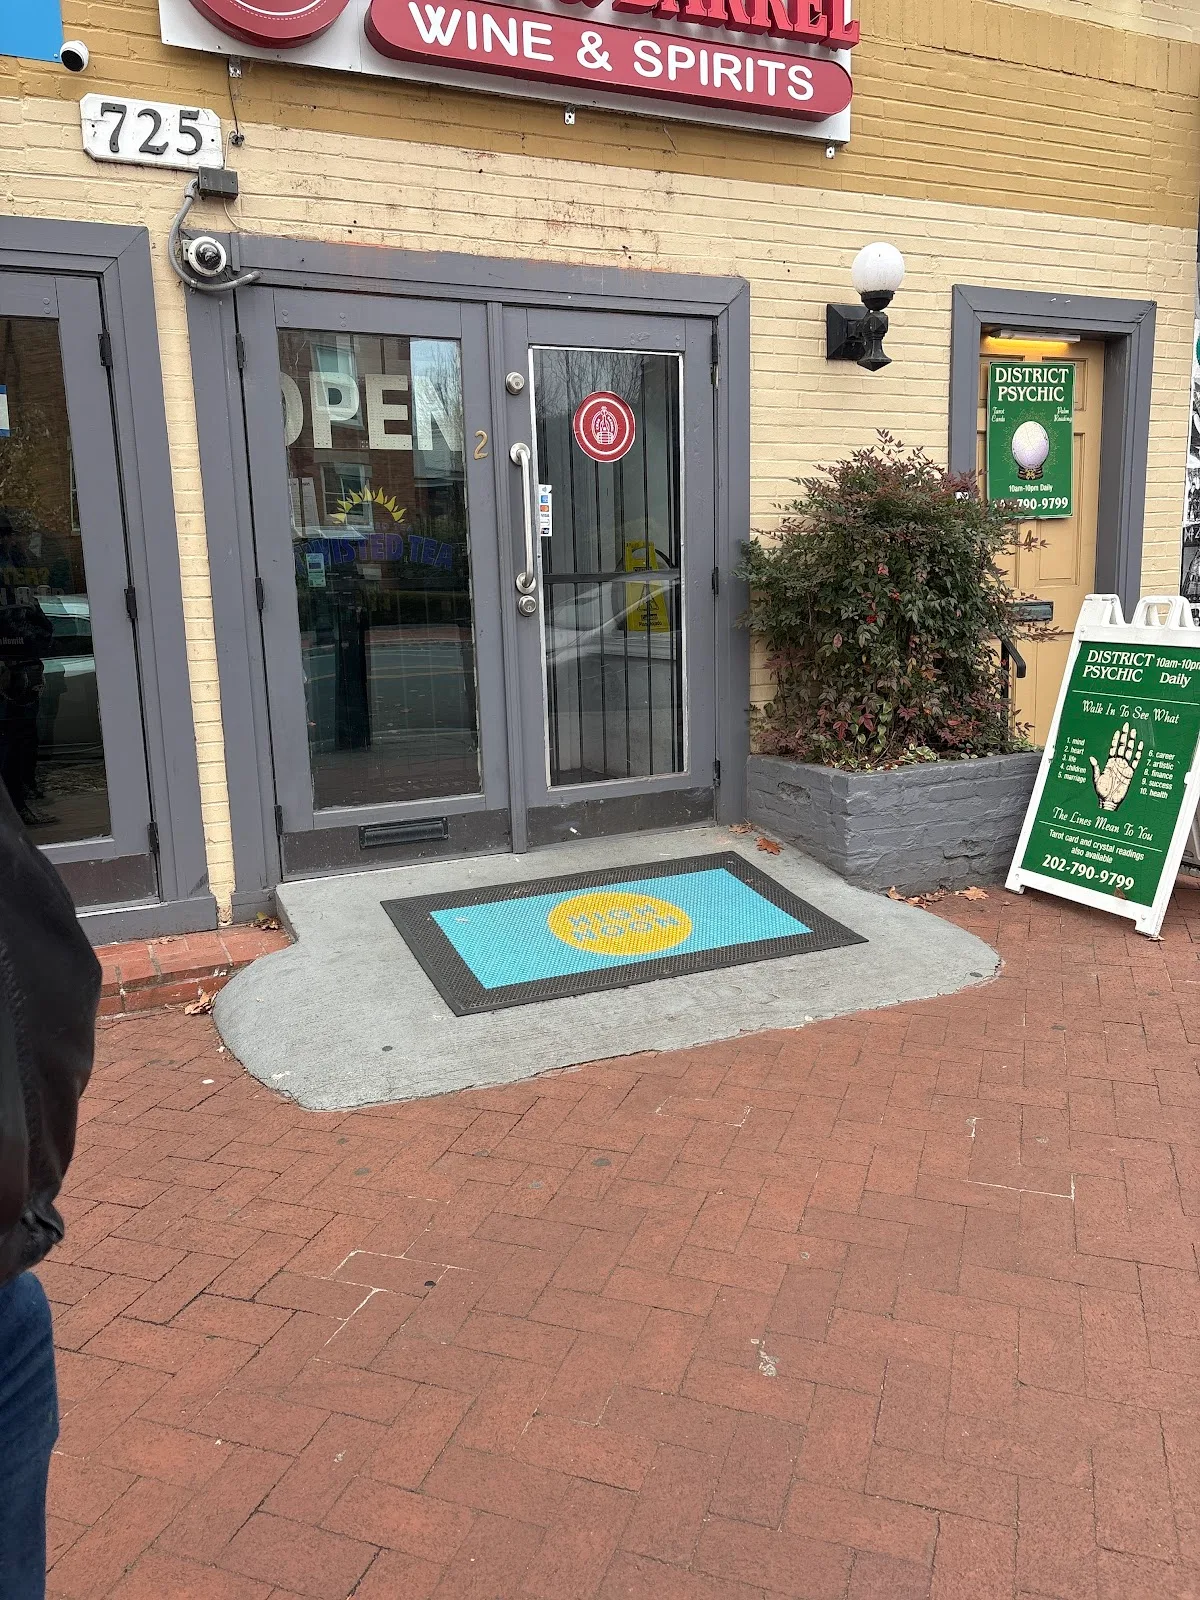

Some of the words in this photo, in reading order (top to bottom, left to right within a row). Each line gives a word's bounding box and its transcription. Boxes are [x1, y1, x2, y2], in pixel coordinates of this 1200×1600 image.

[612, 0, 860, 50] REL
[408, 1, 555, 62] WINE
[576, 30, 613, 72] &
[633, 39, 814, 101] SPIRITS
[101, 102, 203, 155] 725
[995, 367, 1069, 383] DISTRICT
[997, 386, 1065, 402] PSYCHIC
[473, 430, 488, 460] 2
[1008, 485, 1039, 493] 10am-10pm
[1040, 484, 1053, 492] Daily
[993, 497, 1068, 511] -790-9799
[408, 534, 454, 572] TEA
[1087, 649, 1155, 667] DISTRICT
[1082, 665, 1143, 682] PSYCHIC
[1160, 672, 1191, 688] Daily
[1082, 700, 1103, 714] Walk
[1105, 703, 1115, 716] In
[1120, 704, 1130, 718] To
[1133, 706, 1149, 720] See
[1153, 708, 1180, 724] What
[1072, 738, 1085, 746] mind
[1070, 747, 1084, 755] heart
[1155, 752, 1175, 760] career
[1066, 764, 1087, 774] children
[1153, 760, 1174, 770] artistic
[1064, 773, 1086, 783] marriage
[1151, 770, 1173, 780] finance
[1149, 779, 1173, 790] success
[1149, 788, 1168, 799] health
[1052, 806, 1068, 821] The
[1069, 811, 1092, 827] Lines
[1094, 816, 1120, 833] Mean
[1124, 823, 1134, 837] To
[1138, 825, 1154, 841] You
[1049, 829, 1064, 840] Tarot
[1065, 832, 1079, 843] card
[1080, 836, 1092, 847] and
[1093, 840, 1115, 854] crystal
[1116, 847, 1145, 862] readings
[1071, 846, 1084, 856] also
[1085, 850, 1113, 864] available
[1042, 854, 1135, 891] 202-790-9799
